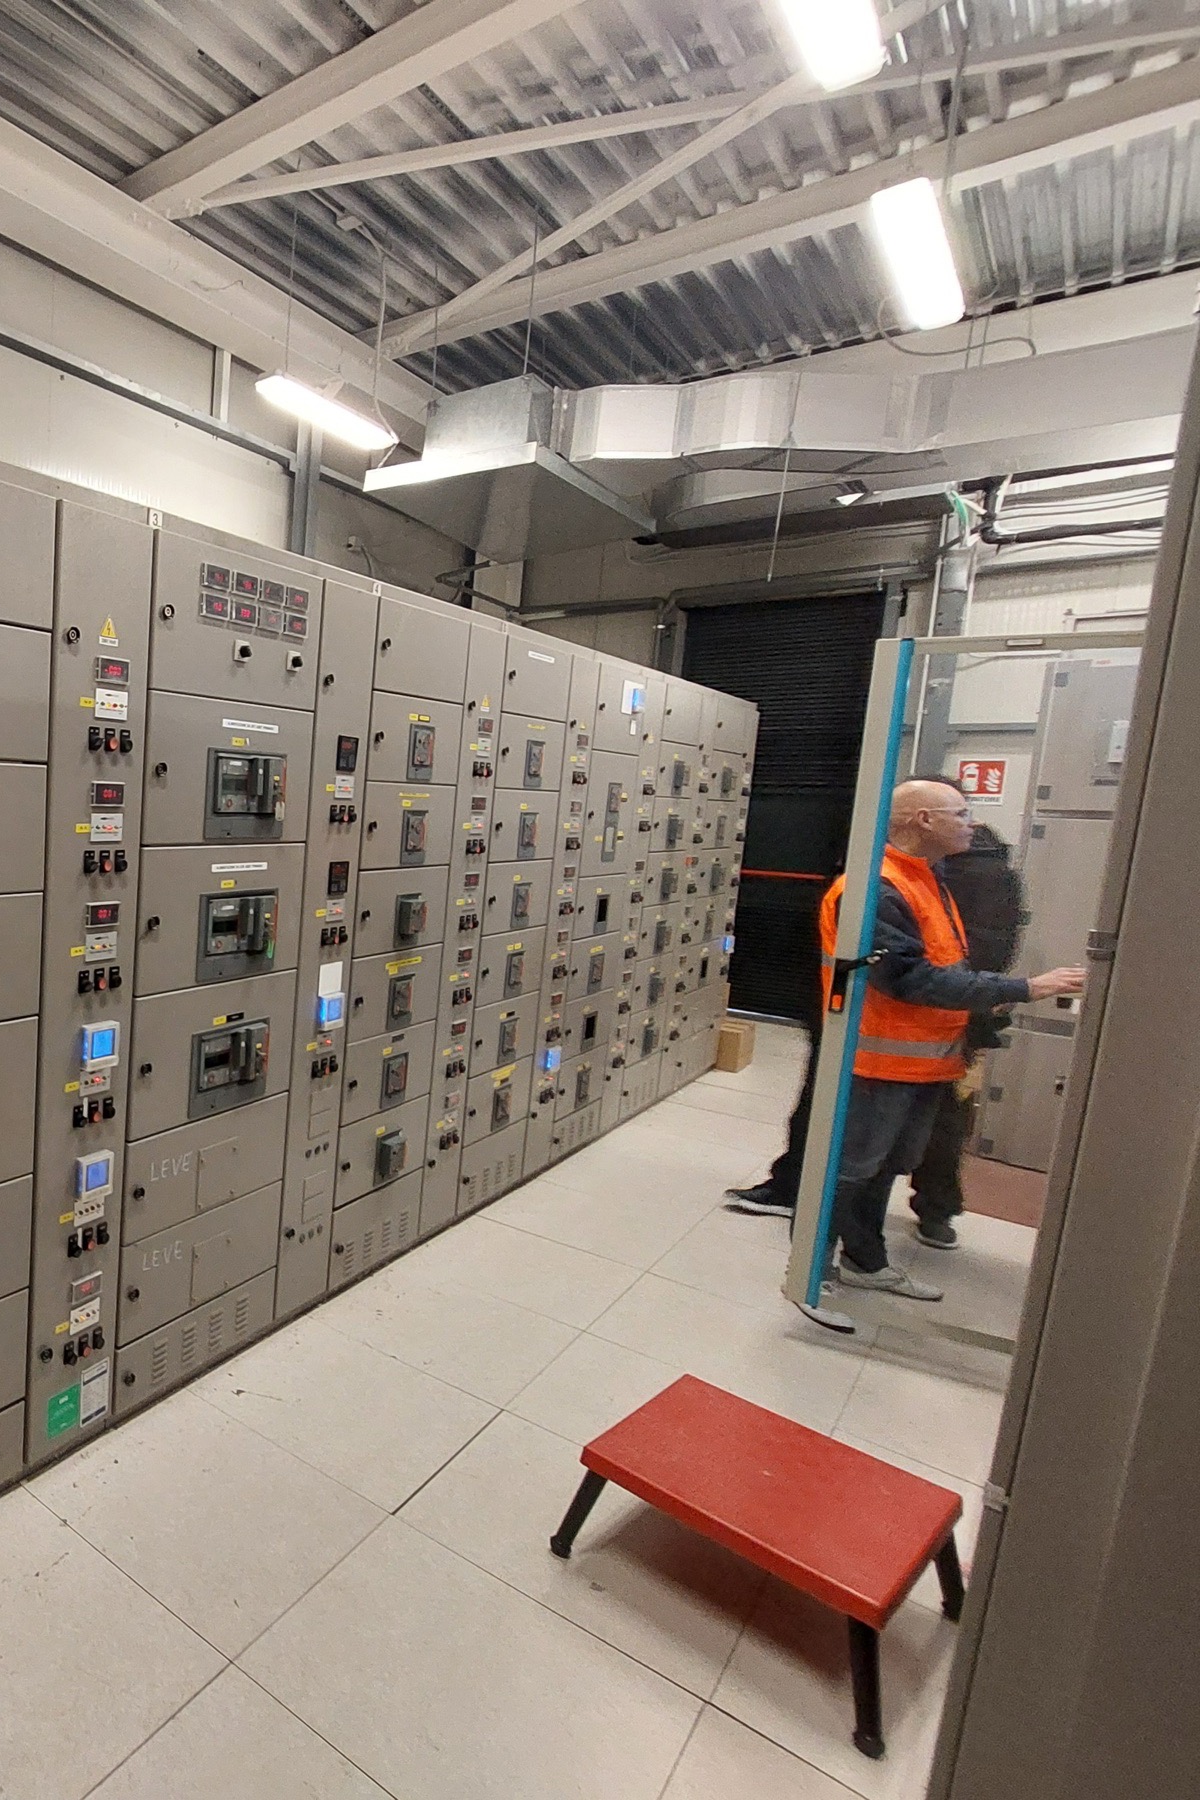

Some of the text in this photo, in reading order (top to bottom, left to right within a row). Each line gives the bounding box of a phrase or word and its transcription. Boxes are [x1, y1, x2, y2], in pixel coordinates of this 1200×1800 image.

[152, 513, 159, 527] 3
[150, 1150, 194, 1182] LEVE
[142, 1240, 184, 1272] LEVE
